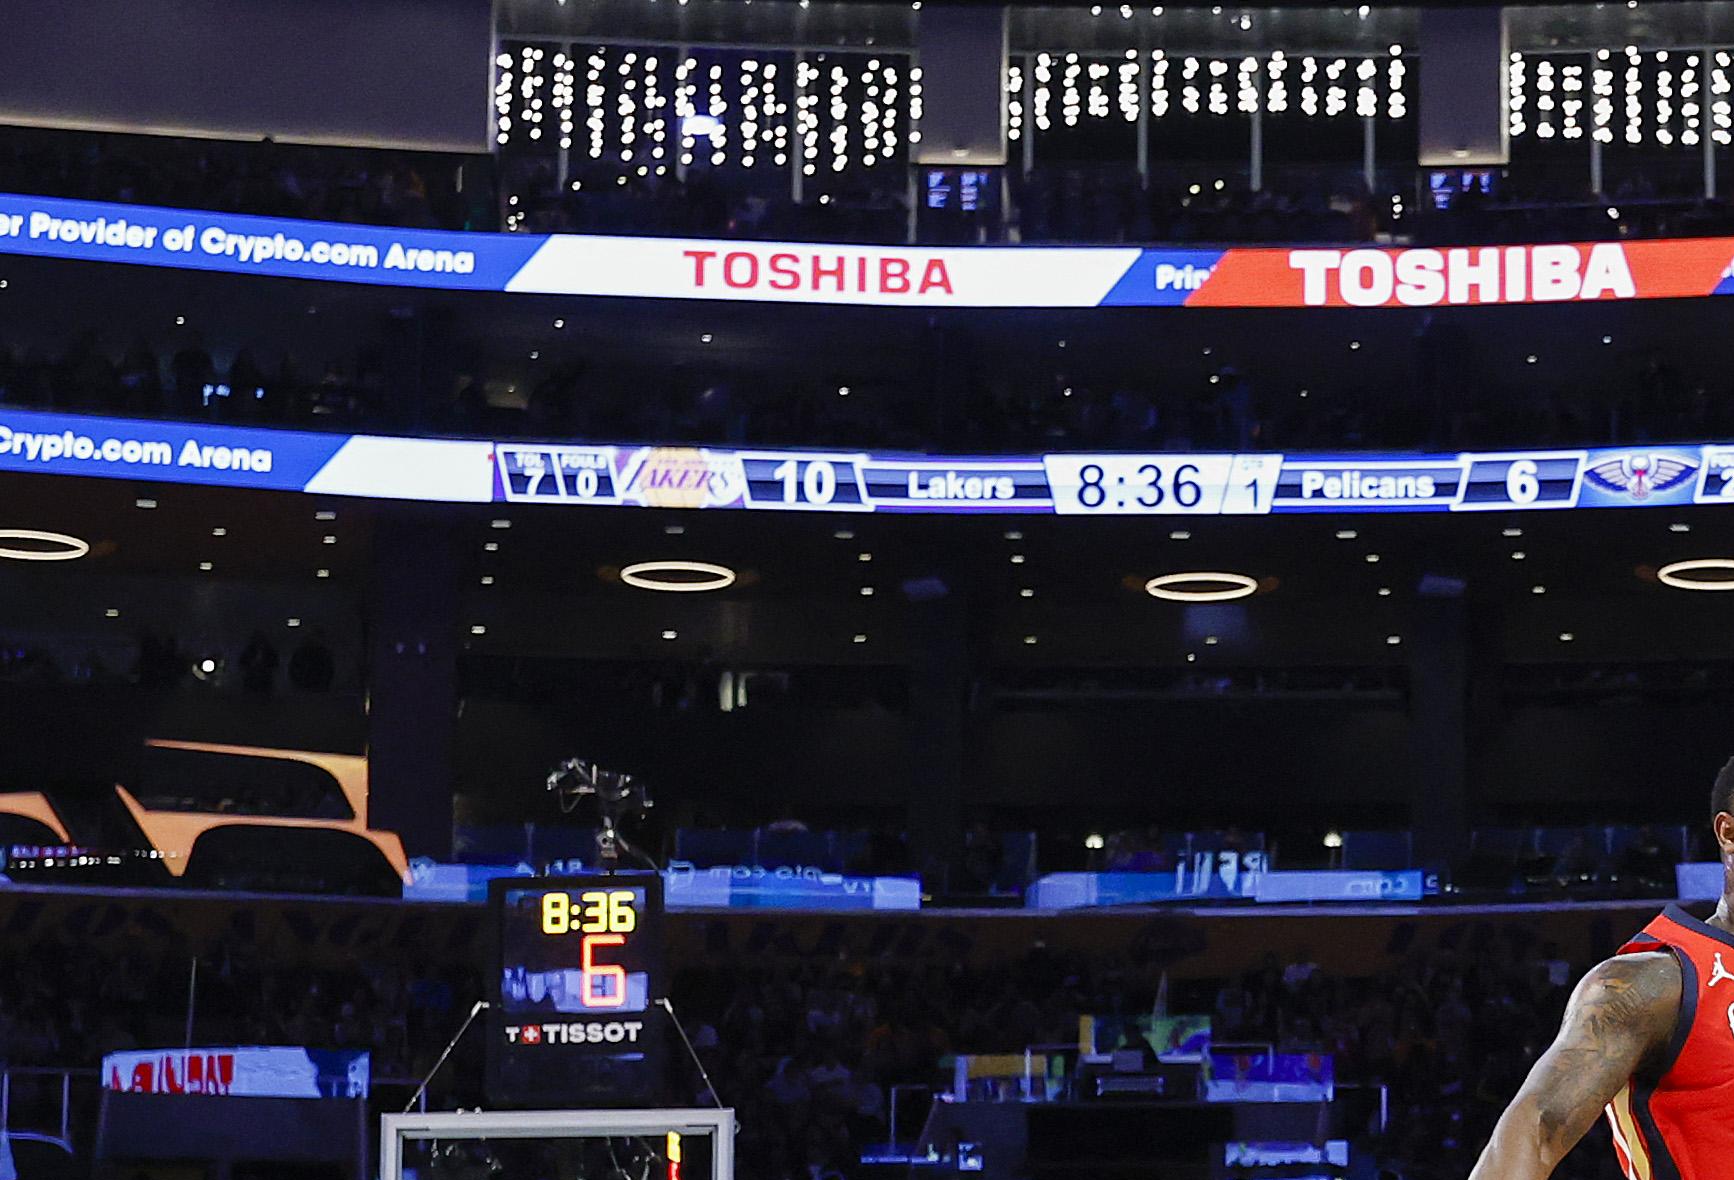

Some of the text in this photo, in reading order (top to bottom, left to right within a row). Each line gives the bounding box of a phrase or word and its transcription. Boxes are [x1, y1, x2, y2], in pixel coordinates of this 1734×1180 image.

[30, 211, 158, 248] Provider
[162, 225, 195, 253] of
[200, 226, 378, 268] Crypto.com
[383, 243, 475, 274] Arena
[683, 250, 954, 295] TOSHIBA
[1156, 263, 1214, 291] Prin
[1288, 243, 1636, 306] TOSHIBA
[178, 439, 272, 472] Arena
[524, 467, 545, 496] 7
[576, 469, 598, 497] 0
[774, 460, 836, 505] 10
[908, 471, 1016, 499] Lakers
[1077, 464, 1201, 507] 8:36
[1245, 478, 1258, 508] 1
[1301, 471, 1435, 499] Pelicans
[1506, 460, 1539, 504] 6
[542, 891, 636, 934] 8:36
[581, 934, 625, 1007] 6
[542, 1022, 643, 1043] TISSOT
